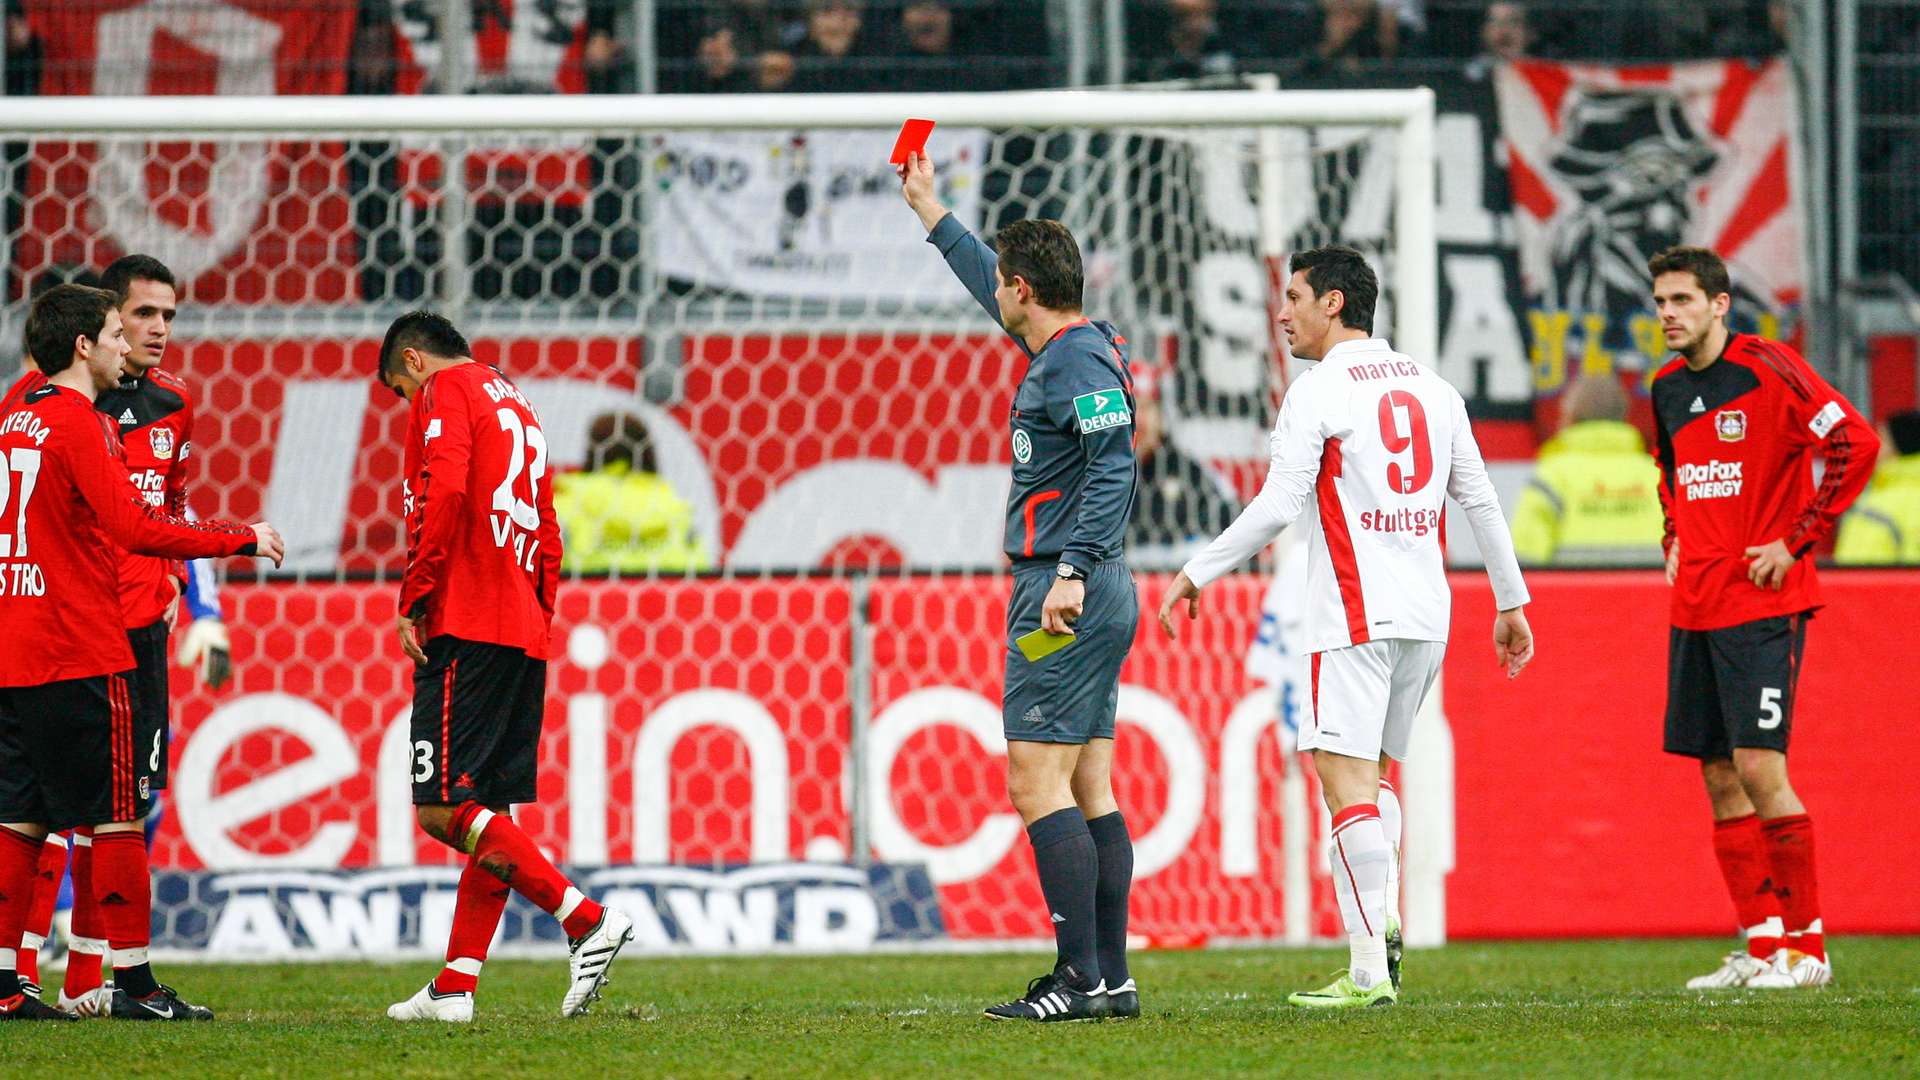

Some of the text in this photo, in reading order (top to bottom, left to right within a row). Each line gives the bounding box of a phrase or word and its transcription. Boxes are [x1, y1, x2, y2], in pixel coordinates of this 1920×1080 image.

[1347, 360, 1420, 382] marica
[1081, 410, 1129, 432] DEKRA
[1378, 389, 1433, 494] 9
[493, 408, 548, 531] 23
[1687, 480, 1744, 502] ENERGY
[1361, 508, 1438, 537] stuttga
[1758, 687, 1783, 730] 5
[150, 728, 161, 772] 8
[409, 740, 435, 783] 3
[602, 886, 879, 950] AWD
